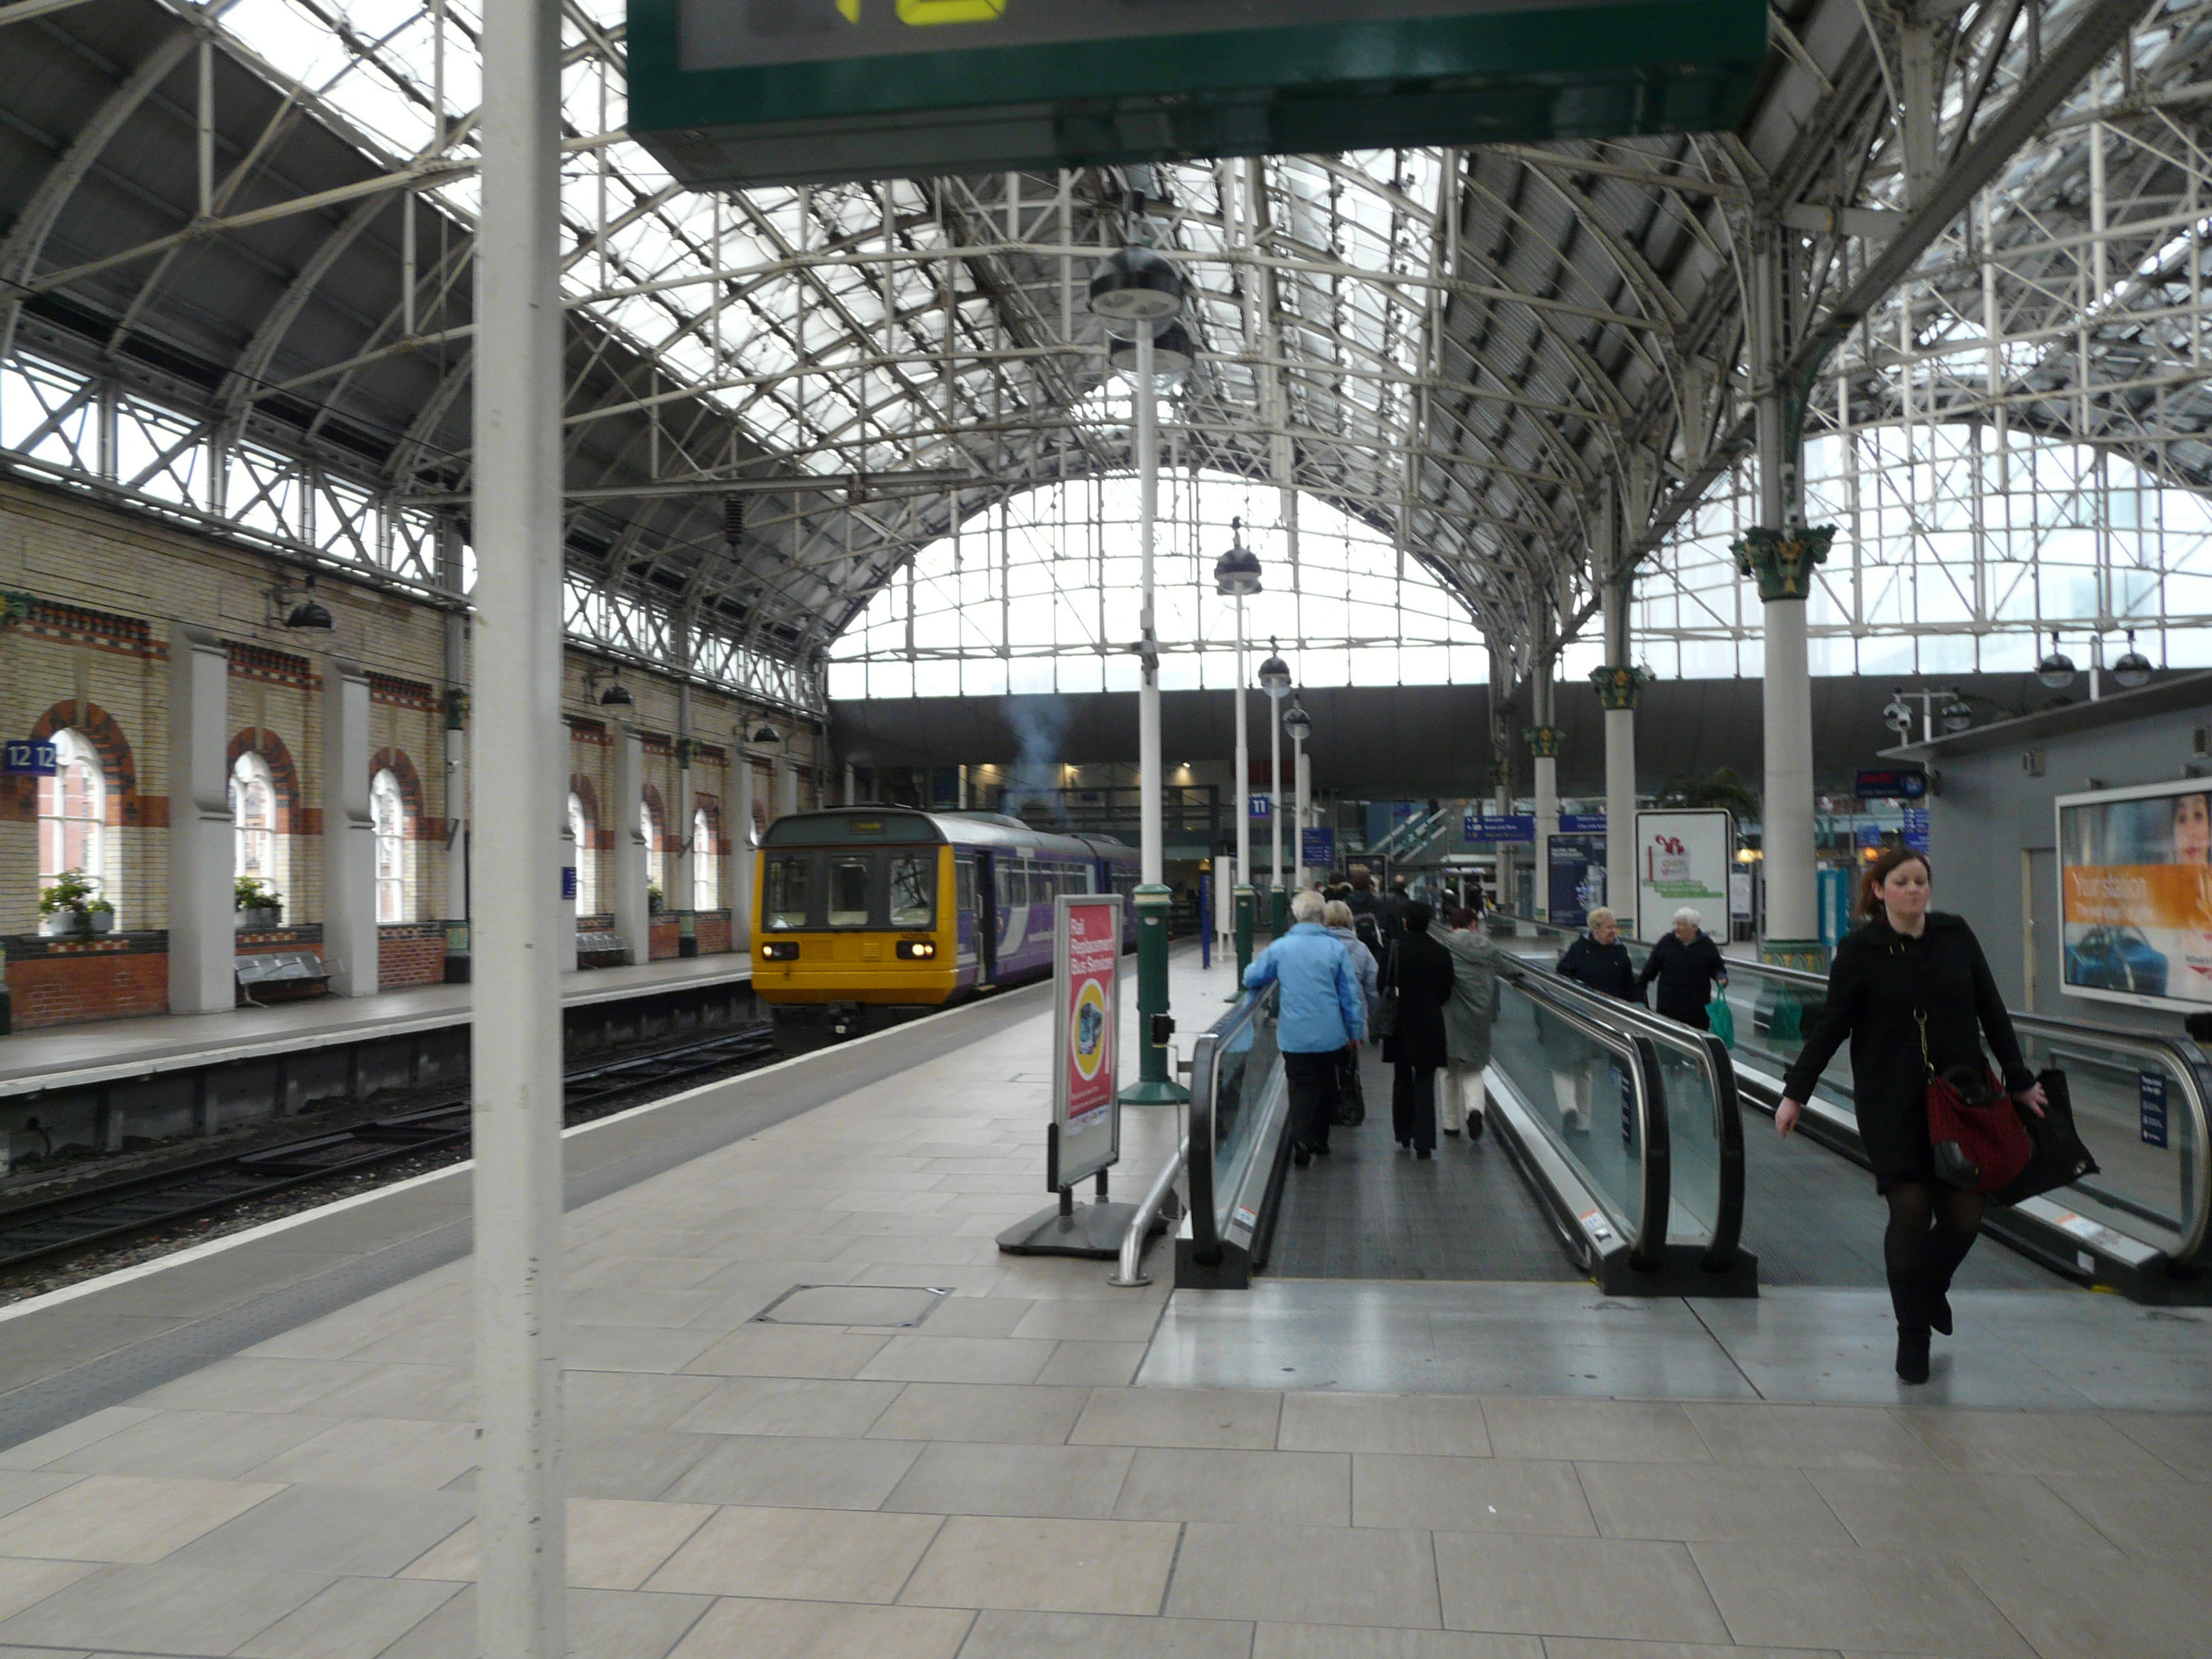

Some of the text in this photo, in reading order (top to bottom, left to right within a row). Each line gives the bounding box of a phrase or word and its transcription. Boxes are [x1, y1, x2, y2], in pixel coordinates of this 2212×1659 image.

[8, 746, 56, 767] 12 12
[1252, 800, 1265, 813] 11
[1071, 917, 1085, 935] Rail
[1071, 937, 1115, 958] Replacement
[1071, 957, 1087, 975] Bus
